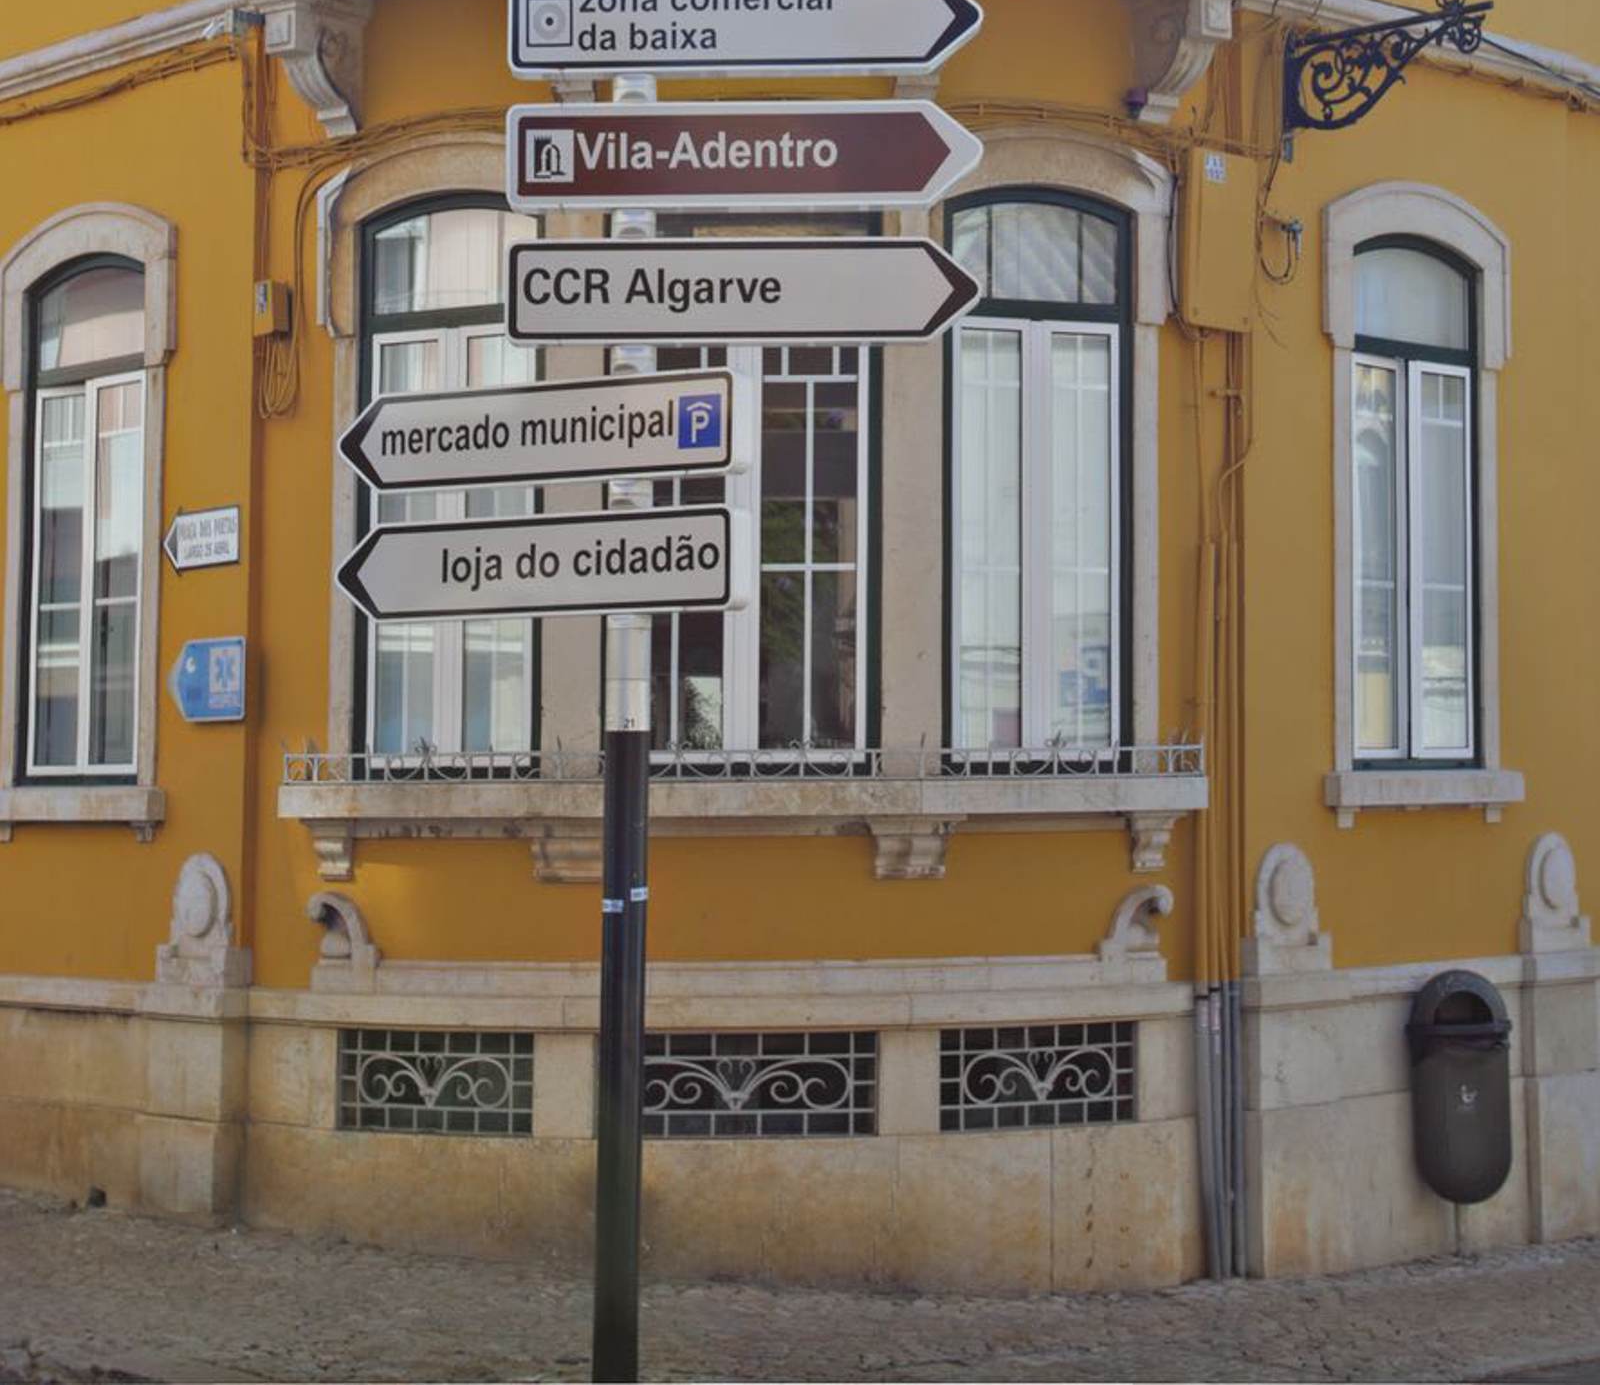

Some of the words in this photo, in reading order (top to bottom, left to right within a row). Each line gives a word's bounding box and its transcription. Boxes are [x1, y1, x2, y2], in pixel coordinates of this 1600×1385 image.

[577, 23, 617, 52] da
[629, 21, 718, 51] baixa
[576, 130, 839, 170] Vila-Adentro
[522, 267, 611, 306] CCR
[624, 268, 782, 314] Algarve
[380, 414, 510, 457] mercado
[520, 399, 675, 449] municipal
[690, 409, 710, 443] P
[441, 546, 503, 592] loja
[515, 543, 560, 579] do
[572, 534, 721, 577] cidadão
